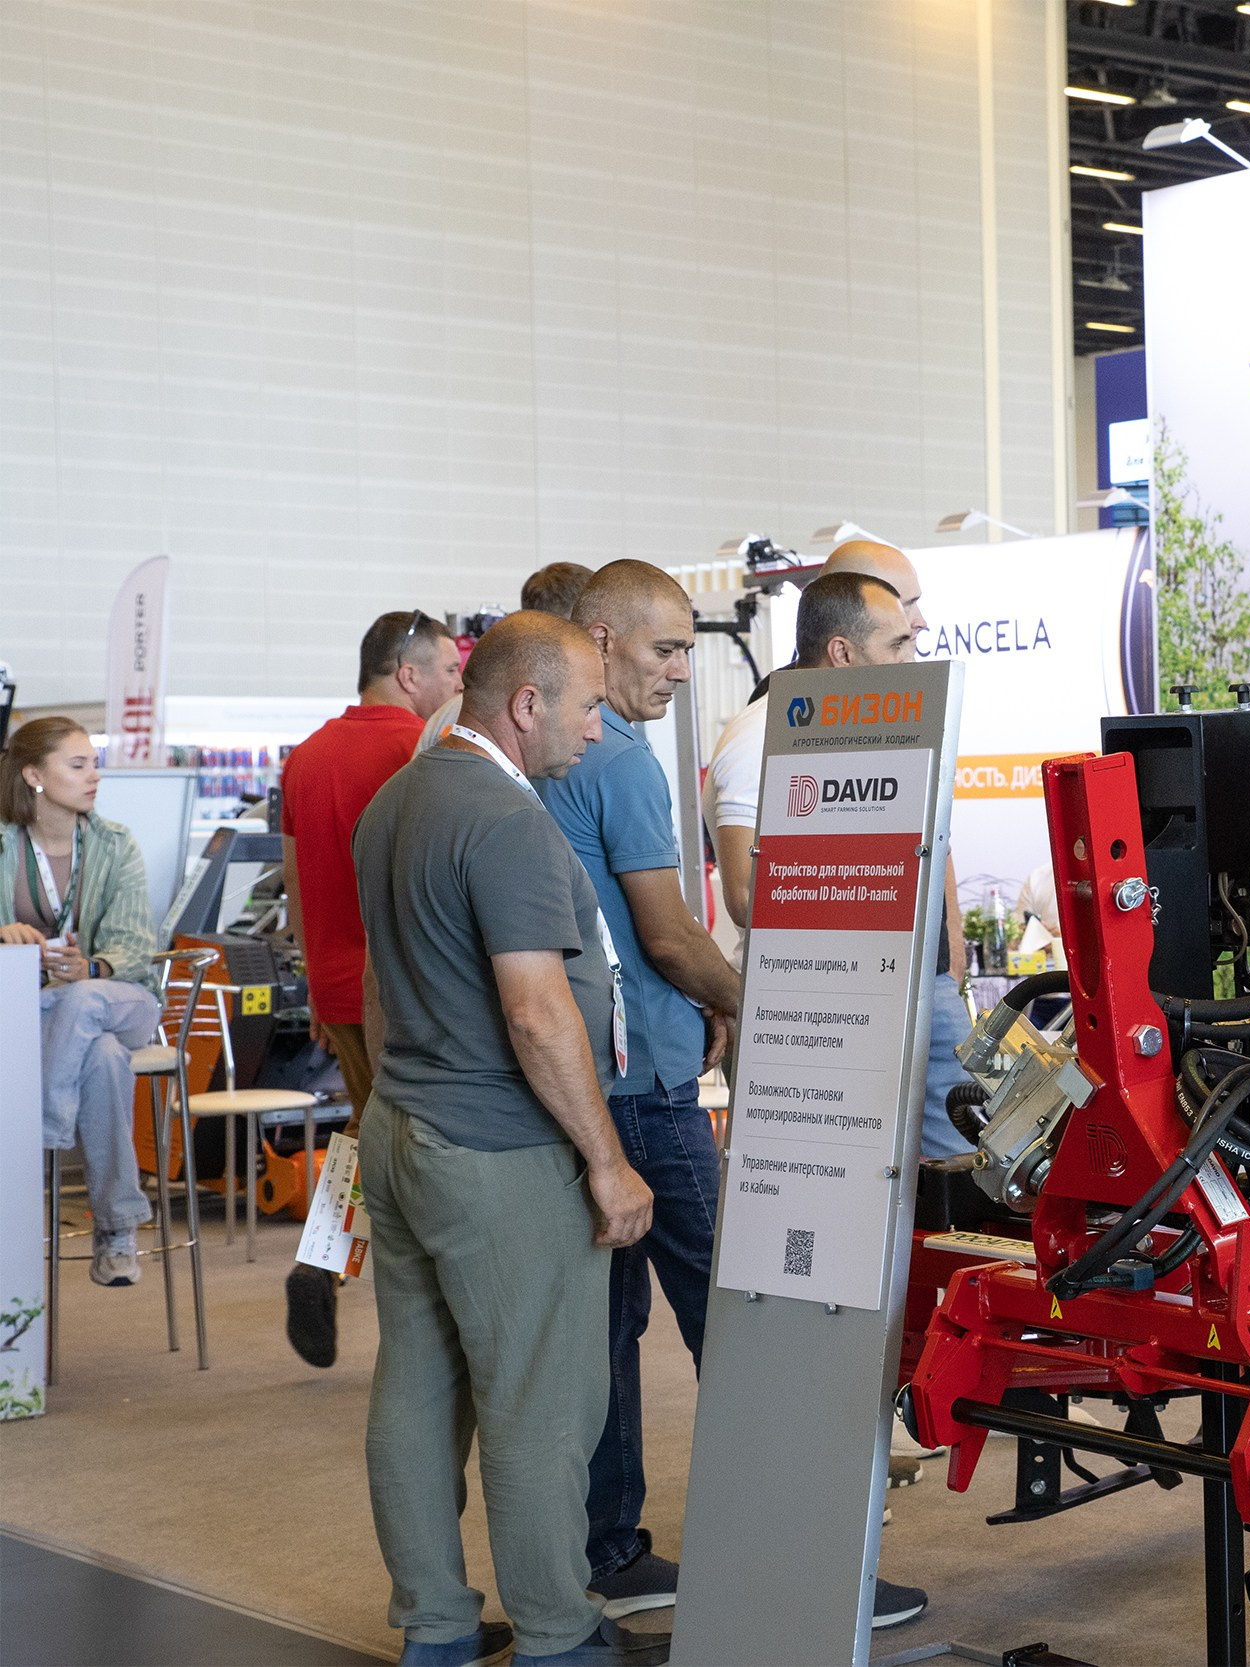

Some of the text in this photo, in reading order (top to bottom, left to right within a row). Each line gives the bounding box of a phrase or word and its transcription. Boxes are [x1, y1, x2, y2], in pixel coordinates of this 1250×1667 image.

[133, 592, 147, 673] PORTER
[915, 617, 1052, 658] CANCELA
[820, 691, 923, 726] БИЗОН
[792, 734, 921, 748] АГРОТЕХНОЛОГИЧЕСКИЙ ХОЛДИНГ
[821, 777, 899, 803] DAVID
[859, 805, 886, 813] SOLUTIONS
[768, 861, 905, 880] Устройство для приствольной
[771, 886, 898, 904] обработки ID David ID-namic
[759, 954, 896, 974] Регулируемая ширина, м 3-4
[755, 1006, 870, 1026] Автономная гидравлическая
[753, 1032, 844, 1049] система с охладителем
[748, 1080, 844, 1103] Возможность установки
[746, 1107, 882, 1131] моторизированных инструментов
[741, 1153, 846, 1178] Управление интерстоками
[739, 1179, 780, 1196] из кабины
